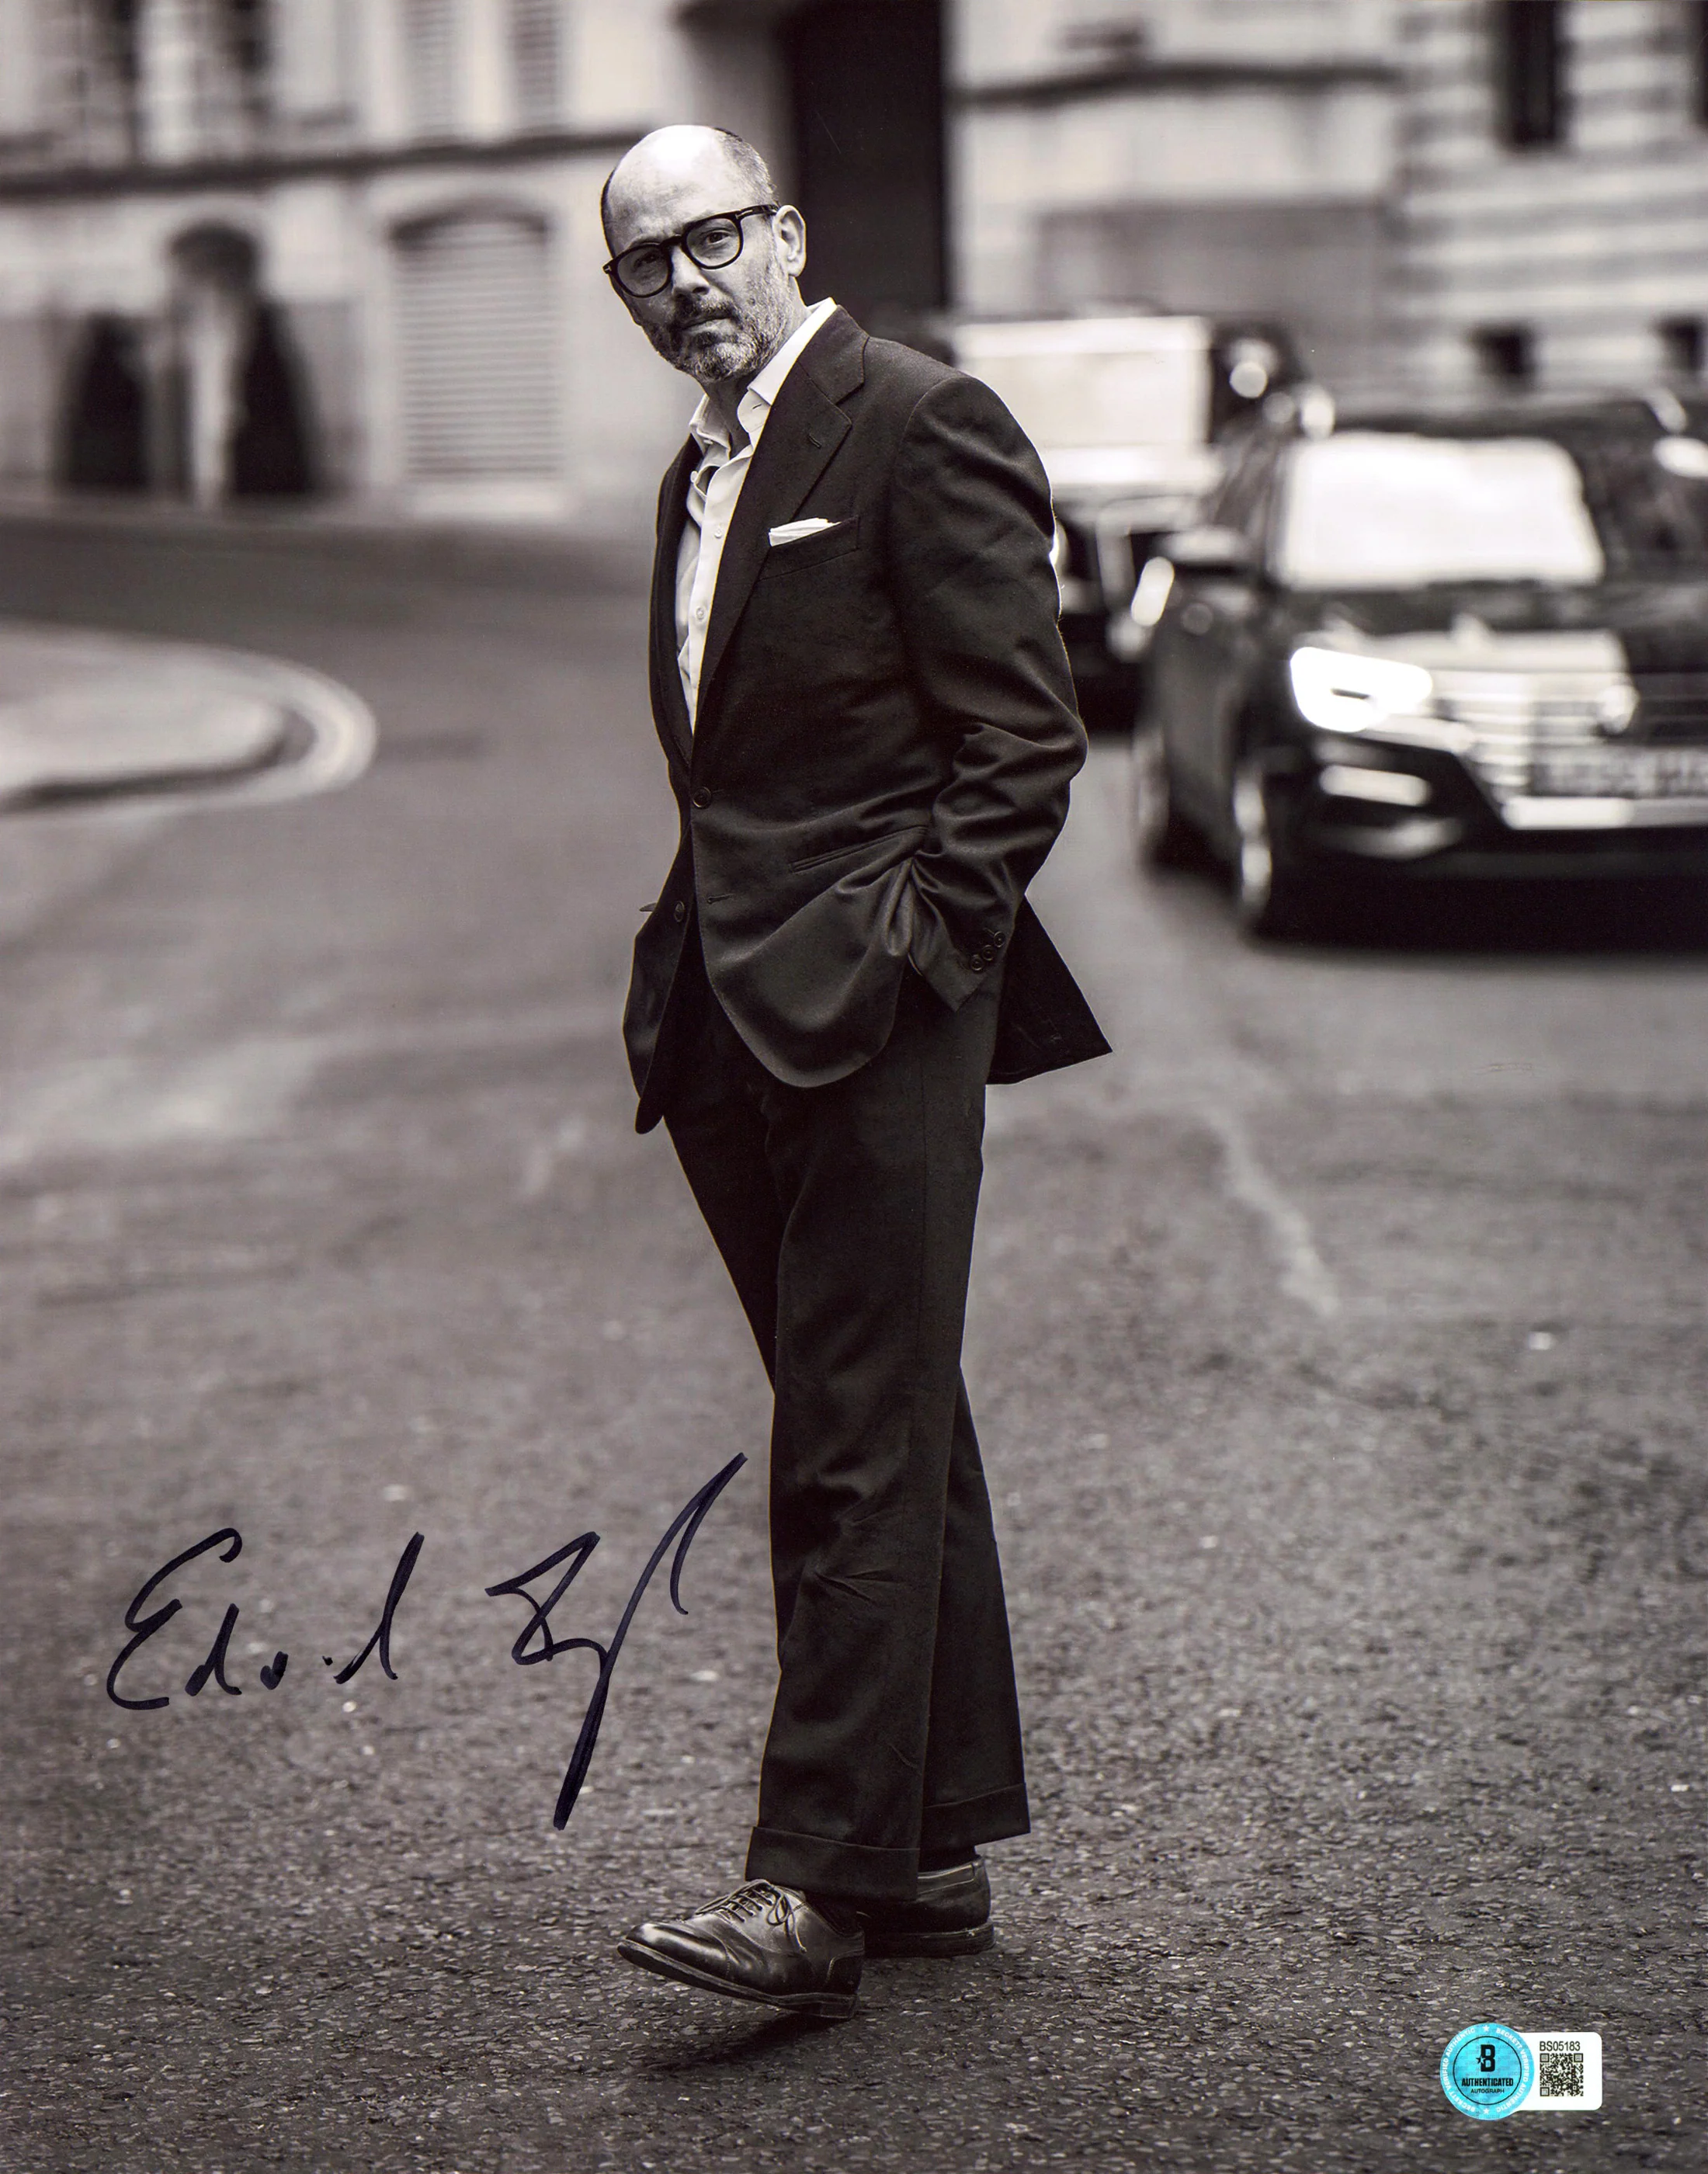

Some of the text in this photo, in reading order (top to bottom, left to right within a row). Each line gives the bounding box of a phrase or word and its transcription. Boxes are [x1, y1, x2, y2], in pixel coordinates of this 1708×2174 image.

[1446, 2027, 1476, 2058] AUTHENTIC
[1539, 2040, 1581, 2052] BS05183
[1461, 2077, 1514, 2087] AUTHENTICATED
